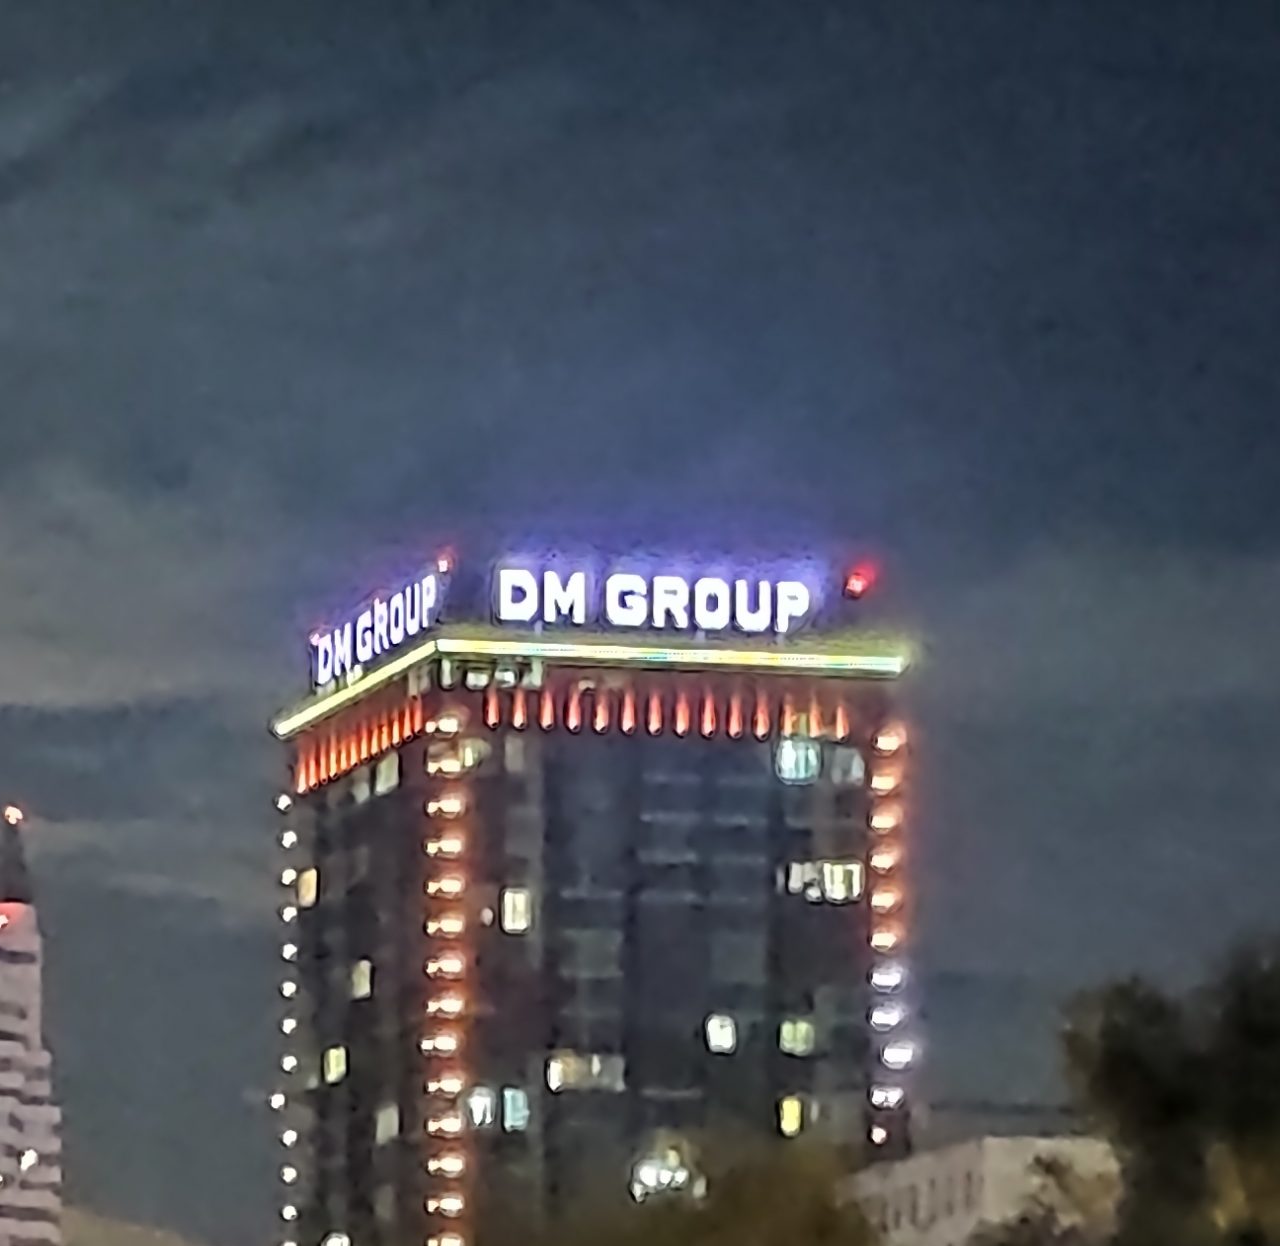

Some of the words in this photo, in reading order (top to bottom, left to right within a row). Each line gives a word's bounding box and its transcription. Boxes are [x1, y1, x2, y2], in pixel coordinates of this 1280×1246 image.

[316, 622, 352, 685] DM
[355, 574, 437, 662] GROUP
[499, 568, 586, 624] DM
[605, 573, 810, 633] GROUP
